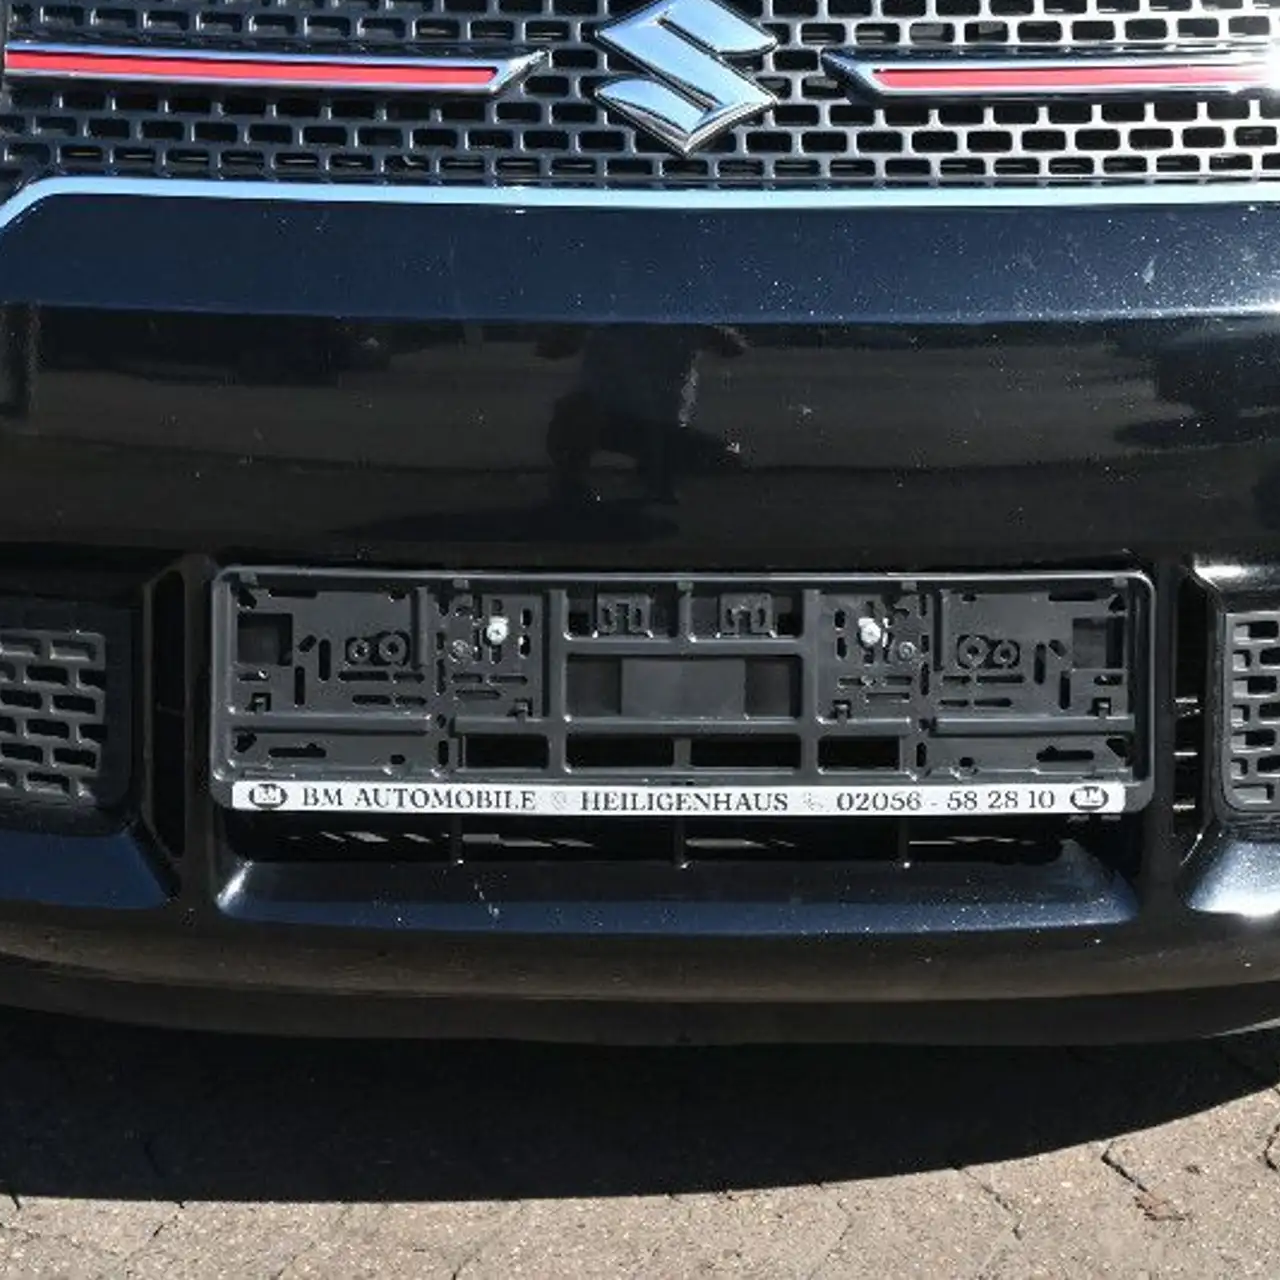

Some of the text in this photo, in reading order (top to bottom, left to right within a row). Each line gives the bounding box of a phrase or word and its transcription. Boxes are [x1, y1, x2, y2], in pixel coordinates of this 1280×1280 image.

[303, 787, 343, 807] BM
[354, 787, 536, 810] AUTOMOBILE
[581, 791, 788, 812] HEILIGENHAUS
[836, 791, 922, 812] 02056
[946, 790, 978, 811] 58
[987, 790, 1019, 810] 28
[1029, 789, 1056, 809] 10
